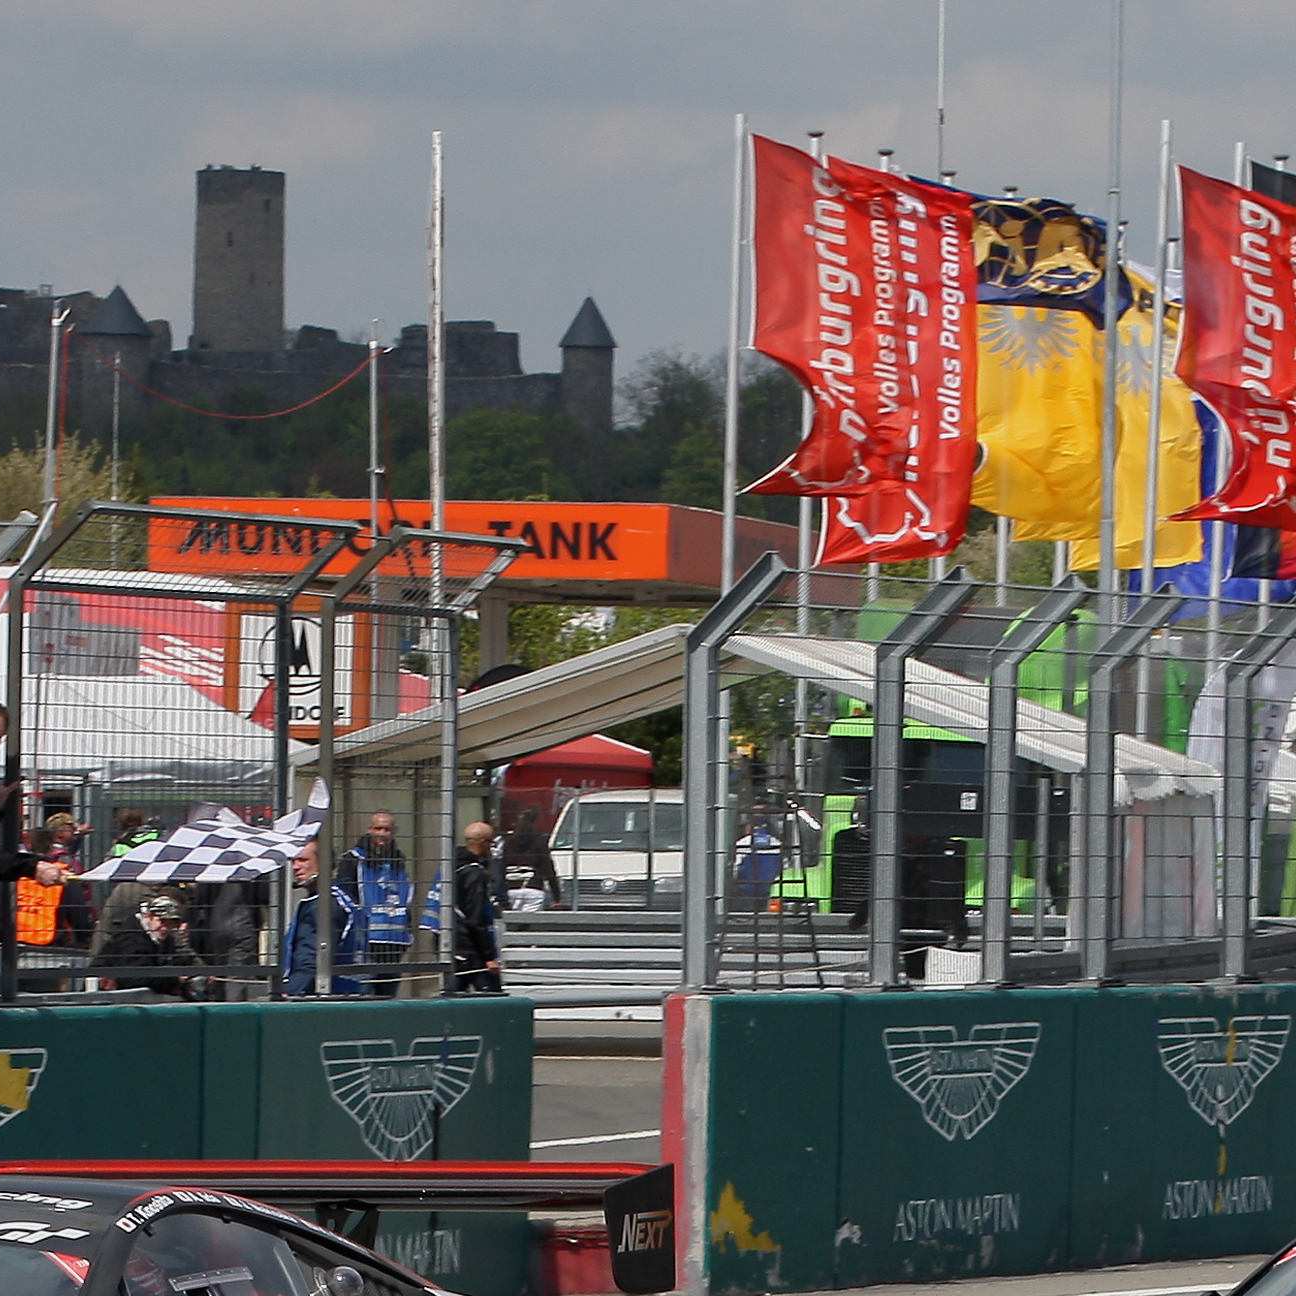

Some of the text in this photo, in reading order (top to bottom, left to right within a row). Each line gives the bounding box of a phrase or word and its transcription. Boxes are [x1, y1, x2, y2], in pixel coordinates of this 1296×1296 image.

[937, 357, 963, 442] Volles
[486, 521, 618, 561] TANK
[617, 1208, 673, 1253] NEXT
